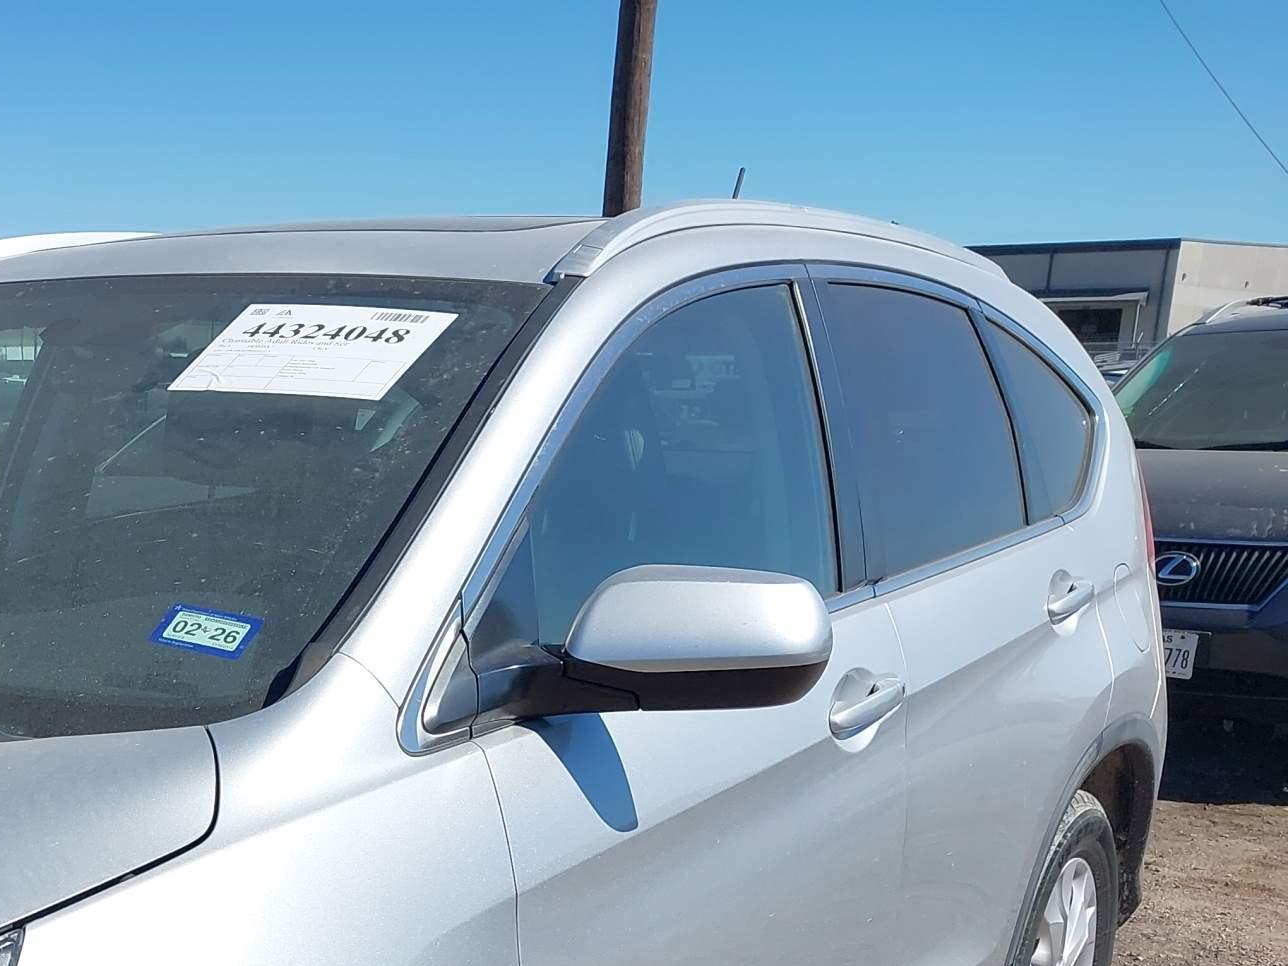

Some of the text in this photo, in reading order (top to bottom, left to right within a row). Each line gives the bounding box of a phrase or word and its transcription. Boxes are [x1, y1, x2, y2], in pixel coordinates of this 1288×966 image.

[242, 322, 411, 344] 44324048
[172, 620, 202, 636] 02
[208, 627, 241, 644] 26
